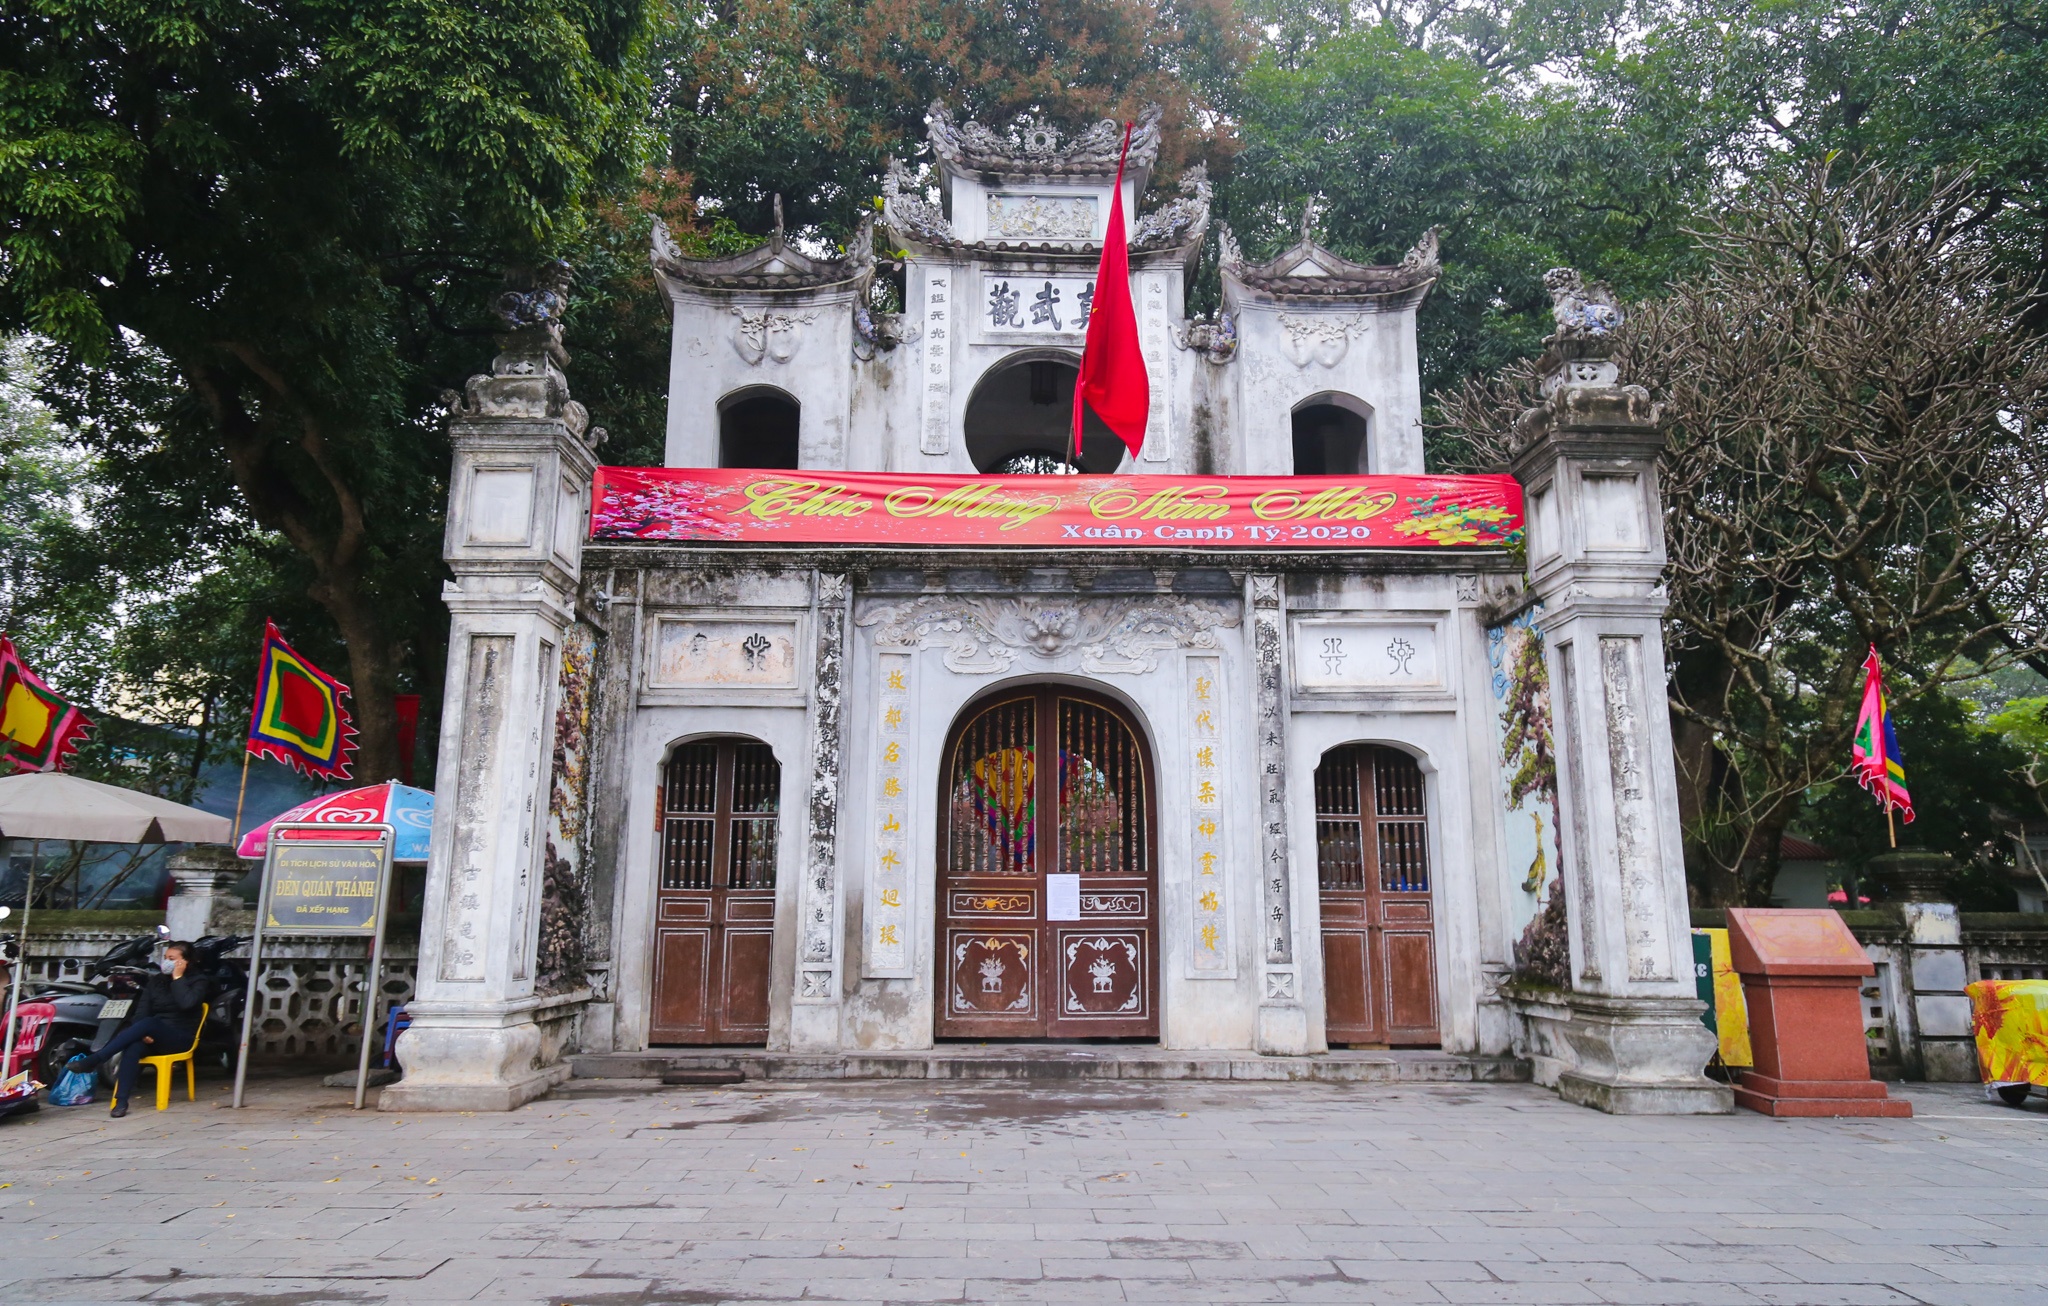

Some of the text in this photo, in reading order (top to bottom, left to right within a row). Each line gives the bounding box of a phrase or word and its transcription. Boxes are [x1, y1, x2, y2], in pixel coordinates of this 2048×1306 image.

[726, 479, 1398, 531] Chúc Mừng Năm Mới
[1061, 524, 1371, 541] Xuân Canh Tý 2020
[309, 860, 327, 868] LỊCH
[301, 875, 334, 897] QUÁN
[335, 875, 376, 897] THÁNH
[309, 904, 325, 913] XẾP
[326, 906, 349, 915] HẠNG
